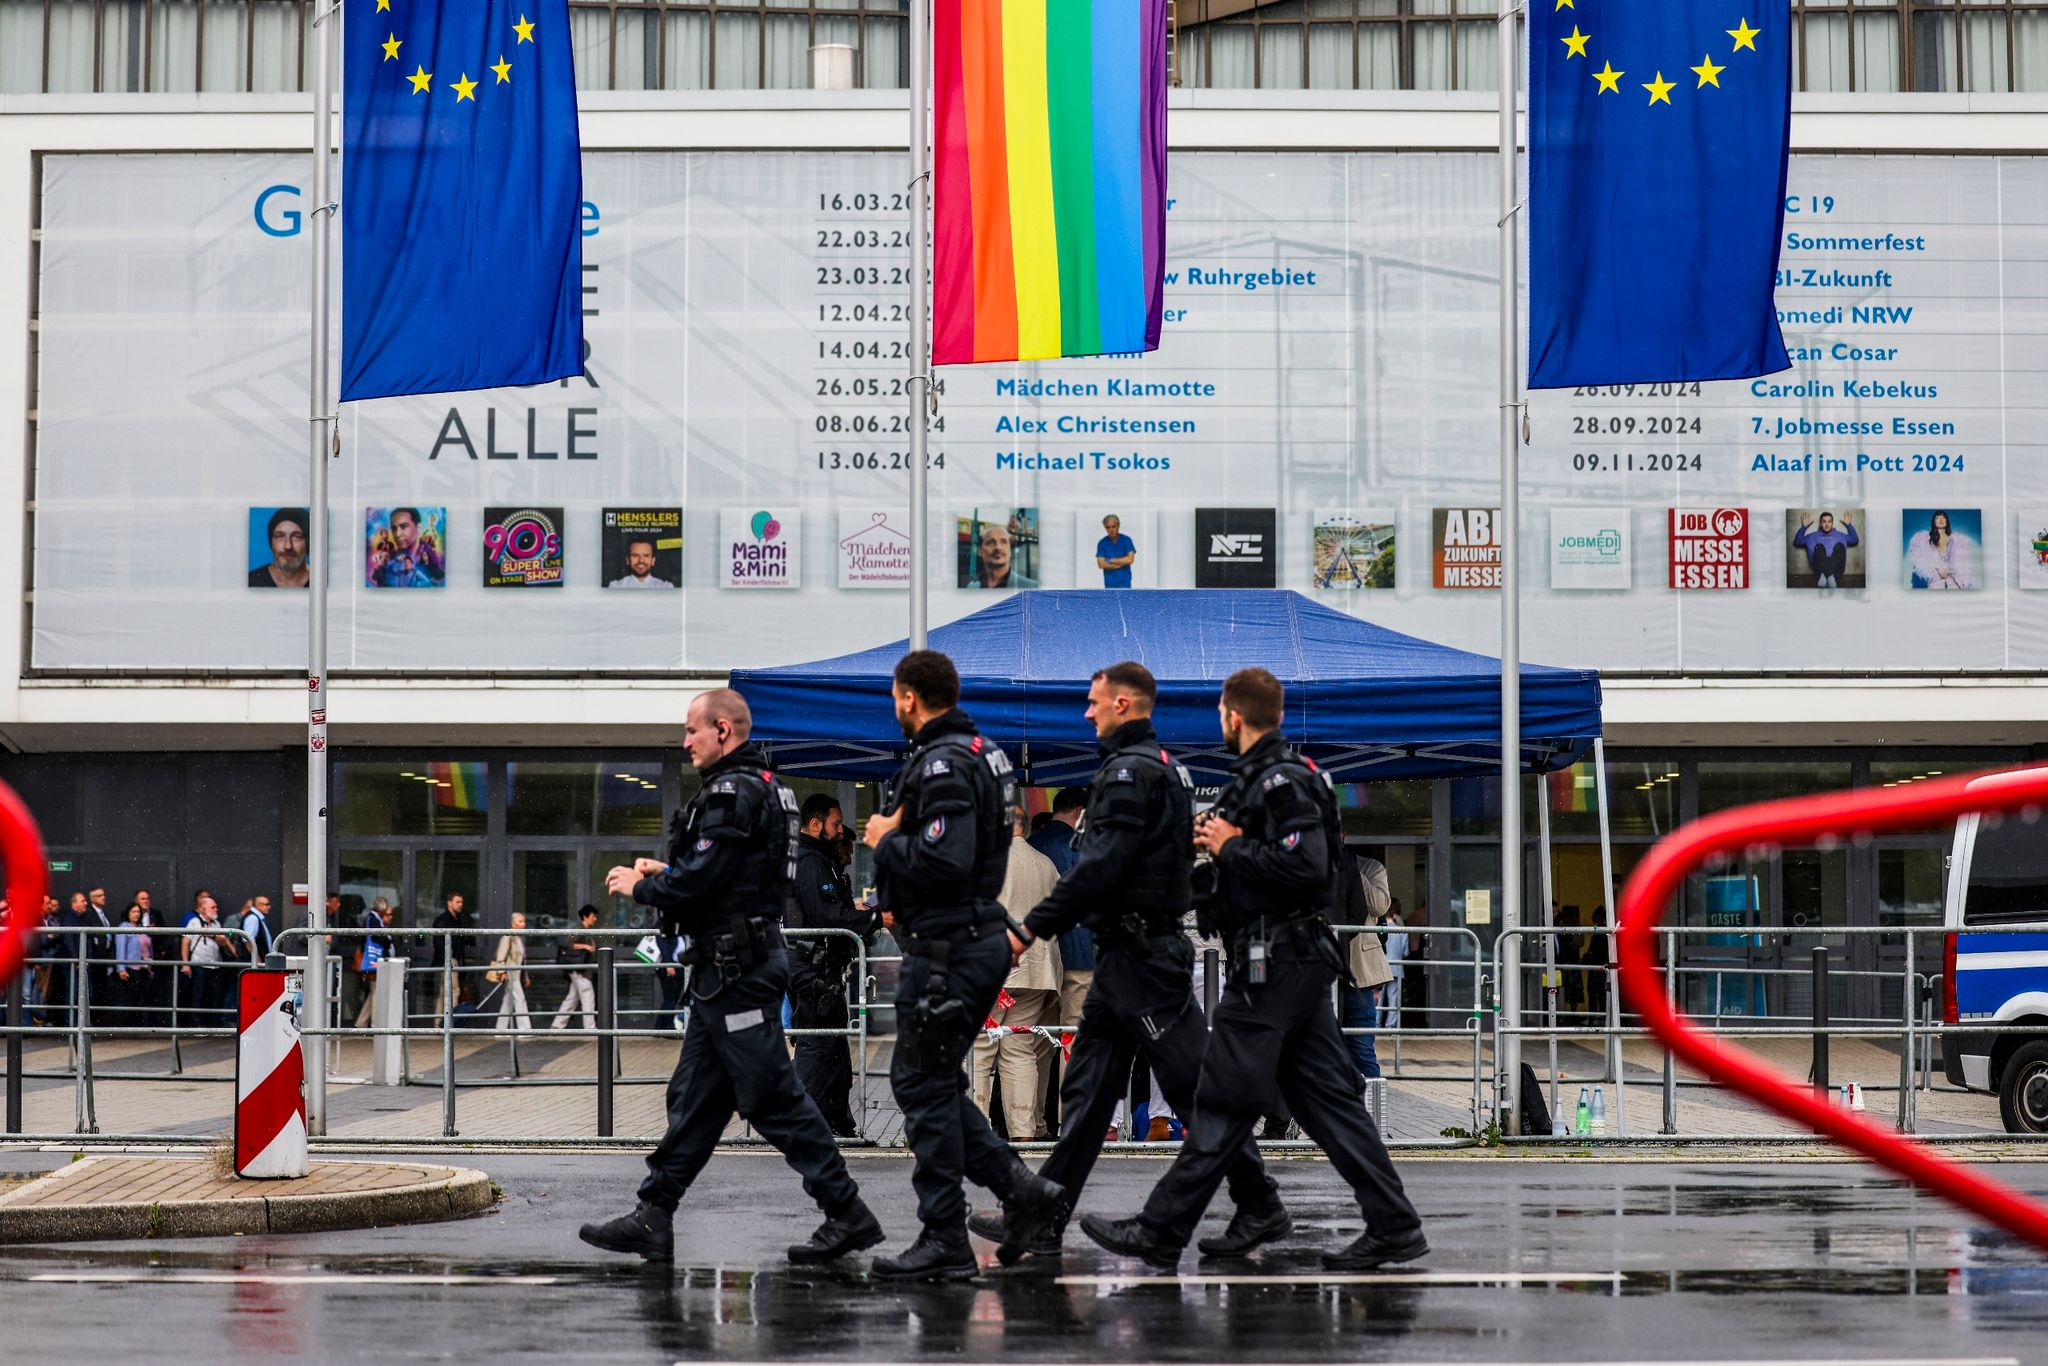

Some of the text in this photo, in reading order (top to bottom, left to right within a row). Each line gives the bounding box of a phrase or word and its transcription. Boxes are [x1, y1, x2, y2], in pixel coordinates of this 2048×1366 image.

[1812, 195, 1835, 213] 19
[1786, 232, 1926, 251] Sommerfest
[1187, 267, 1317, 290] Ruhrgebiet
[1851, 306, 1914, 324] NRW
[1830, 342, 1899, 361] Cosar
[995, 378, 1099, 397] Mädchen
[1107, 378, 1216, 397] Klamotte
[1750, 379, 1835, 398] Carolin
[1843, 379, 1938, 398] Kebekus
[428, 407, 599, 461] ALLE
[995, 415, 1049, 433] Alex
[1056, 415, 1196, 434] Christensen
[1572, 416, 1955, 439] 28.09.2024 7. Jobmesse Essen
[995, 451, 1084, 470] Michael
[1089, 452, 1171, 470] Tsokos
[1572, 453, 1965, 472] 09.11.2024 Alaaf im Pott 2024
[617, 512, 679, 522] HENSSLERS
[1680, 514, 1708, 531] JOB
[1444, 509, 1501, 546] ABI
[732, 541, 787, 560] Mami
[846, 542, 911, 556] Mädchen
[1559, 537, 1618, 548] JOBMEDI
[1674, 538, 1744, 563] MESSE
[848, 555, 910, 571] Klamotte
[1444, 547, 1501, 562] ZUKUNFT
[503, 560, 541, 573] SUPER
[526, 570, 560, 581] SHOW
[1674, 564, 1744, 588] ESSEN
[502, 575, 523, 583] STAGE
[1444, 566, 1501, 587] MESSE
[1711, 912, 1742, 926] GÄSTE
[1722, 1004, 1742, 1015] AfD
